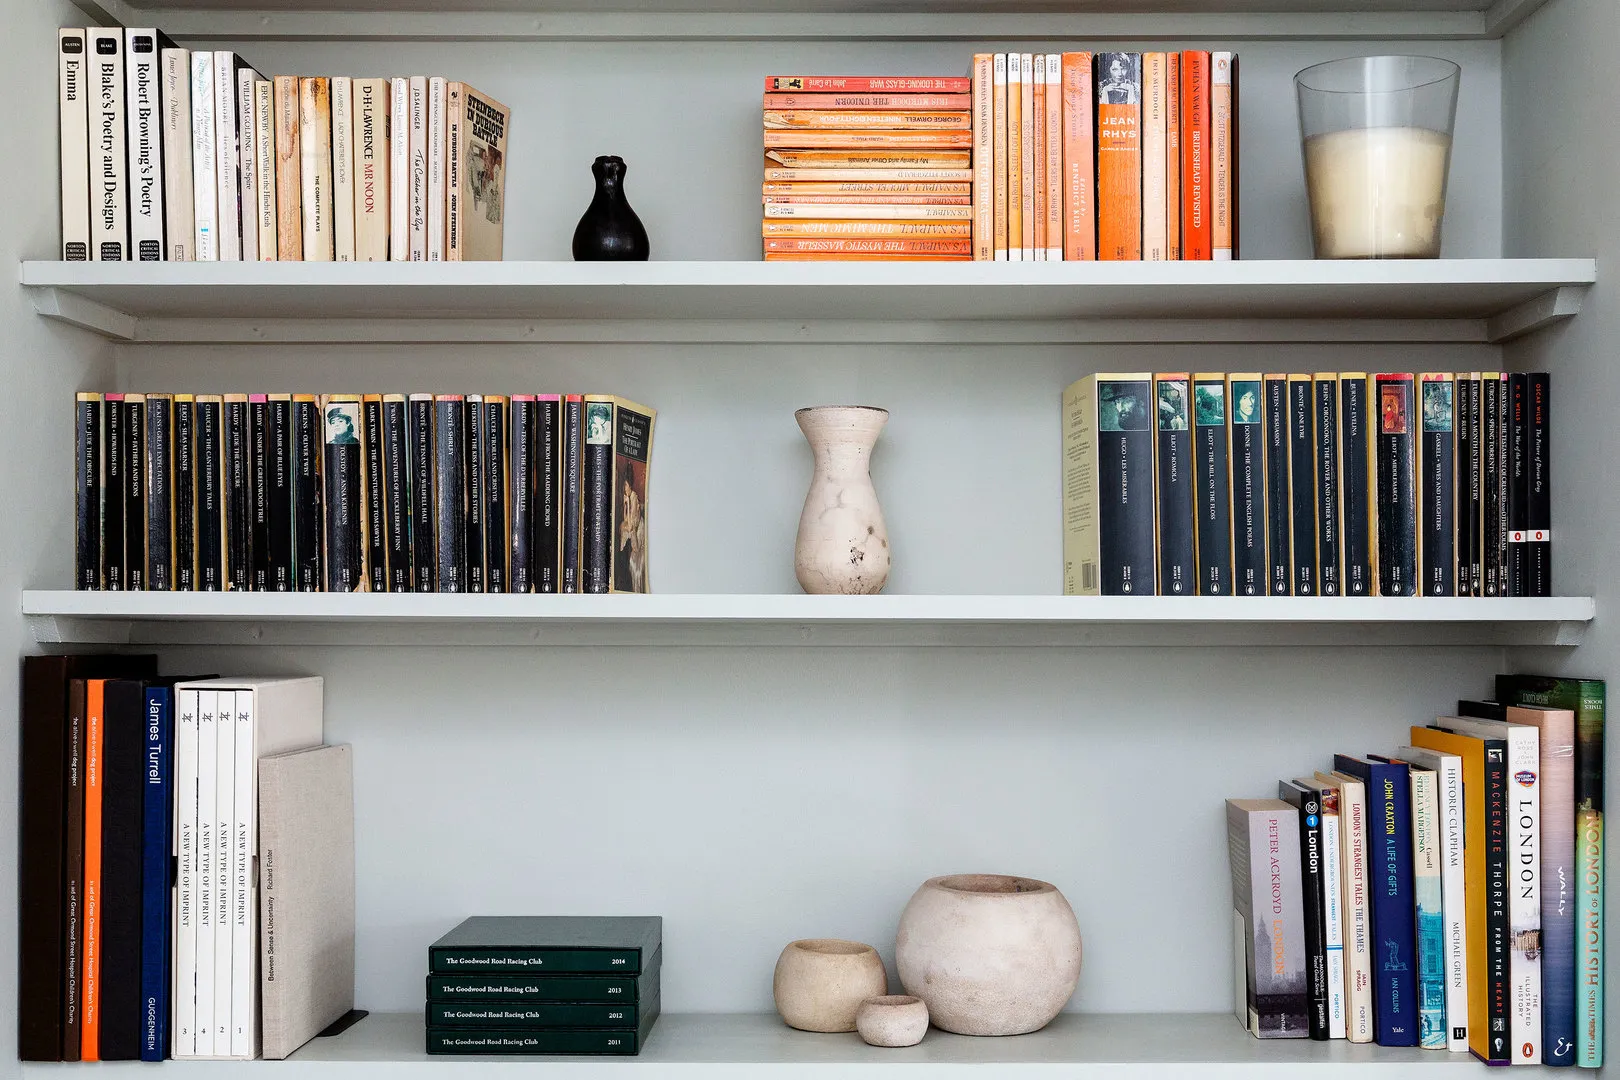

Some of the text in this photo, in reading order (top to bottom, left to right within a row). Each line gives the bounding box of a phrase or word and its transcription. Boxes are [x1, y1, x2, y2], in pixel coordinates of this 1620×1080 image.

[67, 60, 79, 101] Emma
[833, 80, 846, 88] John
[886, 80, 933, 88] LOOKING-GLASS
[1192, 60, 1200, 92] EVELYN
[243, 80, 251, 114] WILLIAM
[261, 105, 269, 131] NEWBY
[137, 63, 153, 217] Robert Browning's Poetry
[244, 115, 252, 151] GOLDING
[1102, 130, 1136, 138] RHYS
[101, 63, 116, 230] Blake's Poetry and Designs
[414, 149, 424, 166] The
[1192, 130, 1201, 182] BRIDESHEAD
[244, 172, 252, 189] Spire
[364, 164, 373, 180] MR
[414, 168, 423, 194] Catcher
[365, 181, 374, 213] NOON
[411, 218, 423, 231] Rye
[797, 241, 843, 251] MASSEUR
[845, 241, 882, 251] MYSTIC
[883, 242, 905, 251] THE
[1209, 480, 1214, 488] ON
[1384, 778, 1393, 799] JOHN
[1385, 802, 1395, 835] CRAXTON
[1448, 768, 1458, 866] HISTORIC CLAPHAM
[1308, 830, 1318, 873] London
[1387, 846, 1396, 861] LIFE
[1492, 772, 1502, 917] MACKENZIE THORPE
[1519, 799, 1534, 900] LONDON
[1353, 839, 1363, 882] STRANGEST
[1388, 863, 1396, 874] OF
[147, 699, 162, 1051] James Turrell GUGGENHEIM
[238, 876, 245, 886] OF
[1388, 876, 1397, 896] GIFTS
[1269, 819, 1285, 975] PETER ACKROYD LONDON
[1354, 884, 1363, 906] TALES
[1557, 866, 1566, 916] WALLY
[1585, 815, 1600, 986] HISTORY OF LONDON
[1355, 908, 1364, 922] THE
[1355, 923, 1364, 953] THAMES
